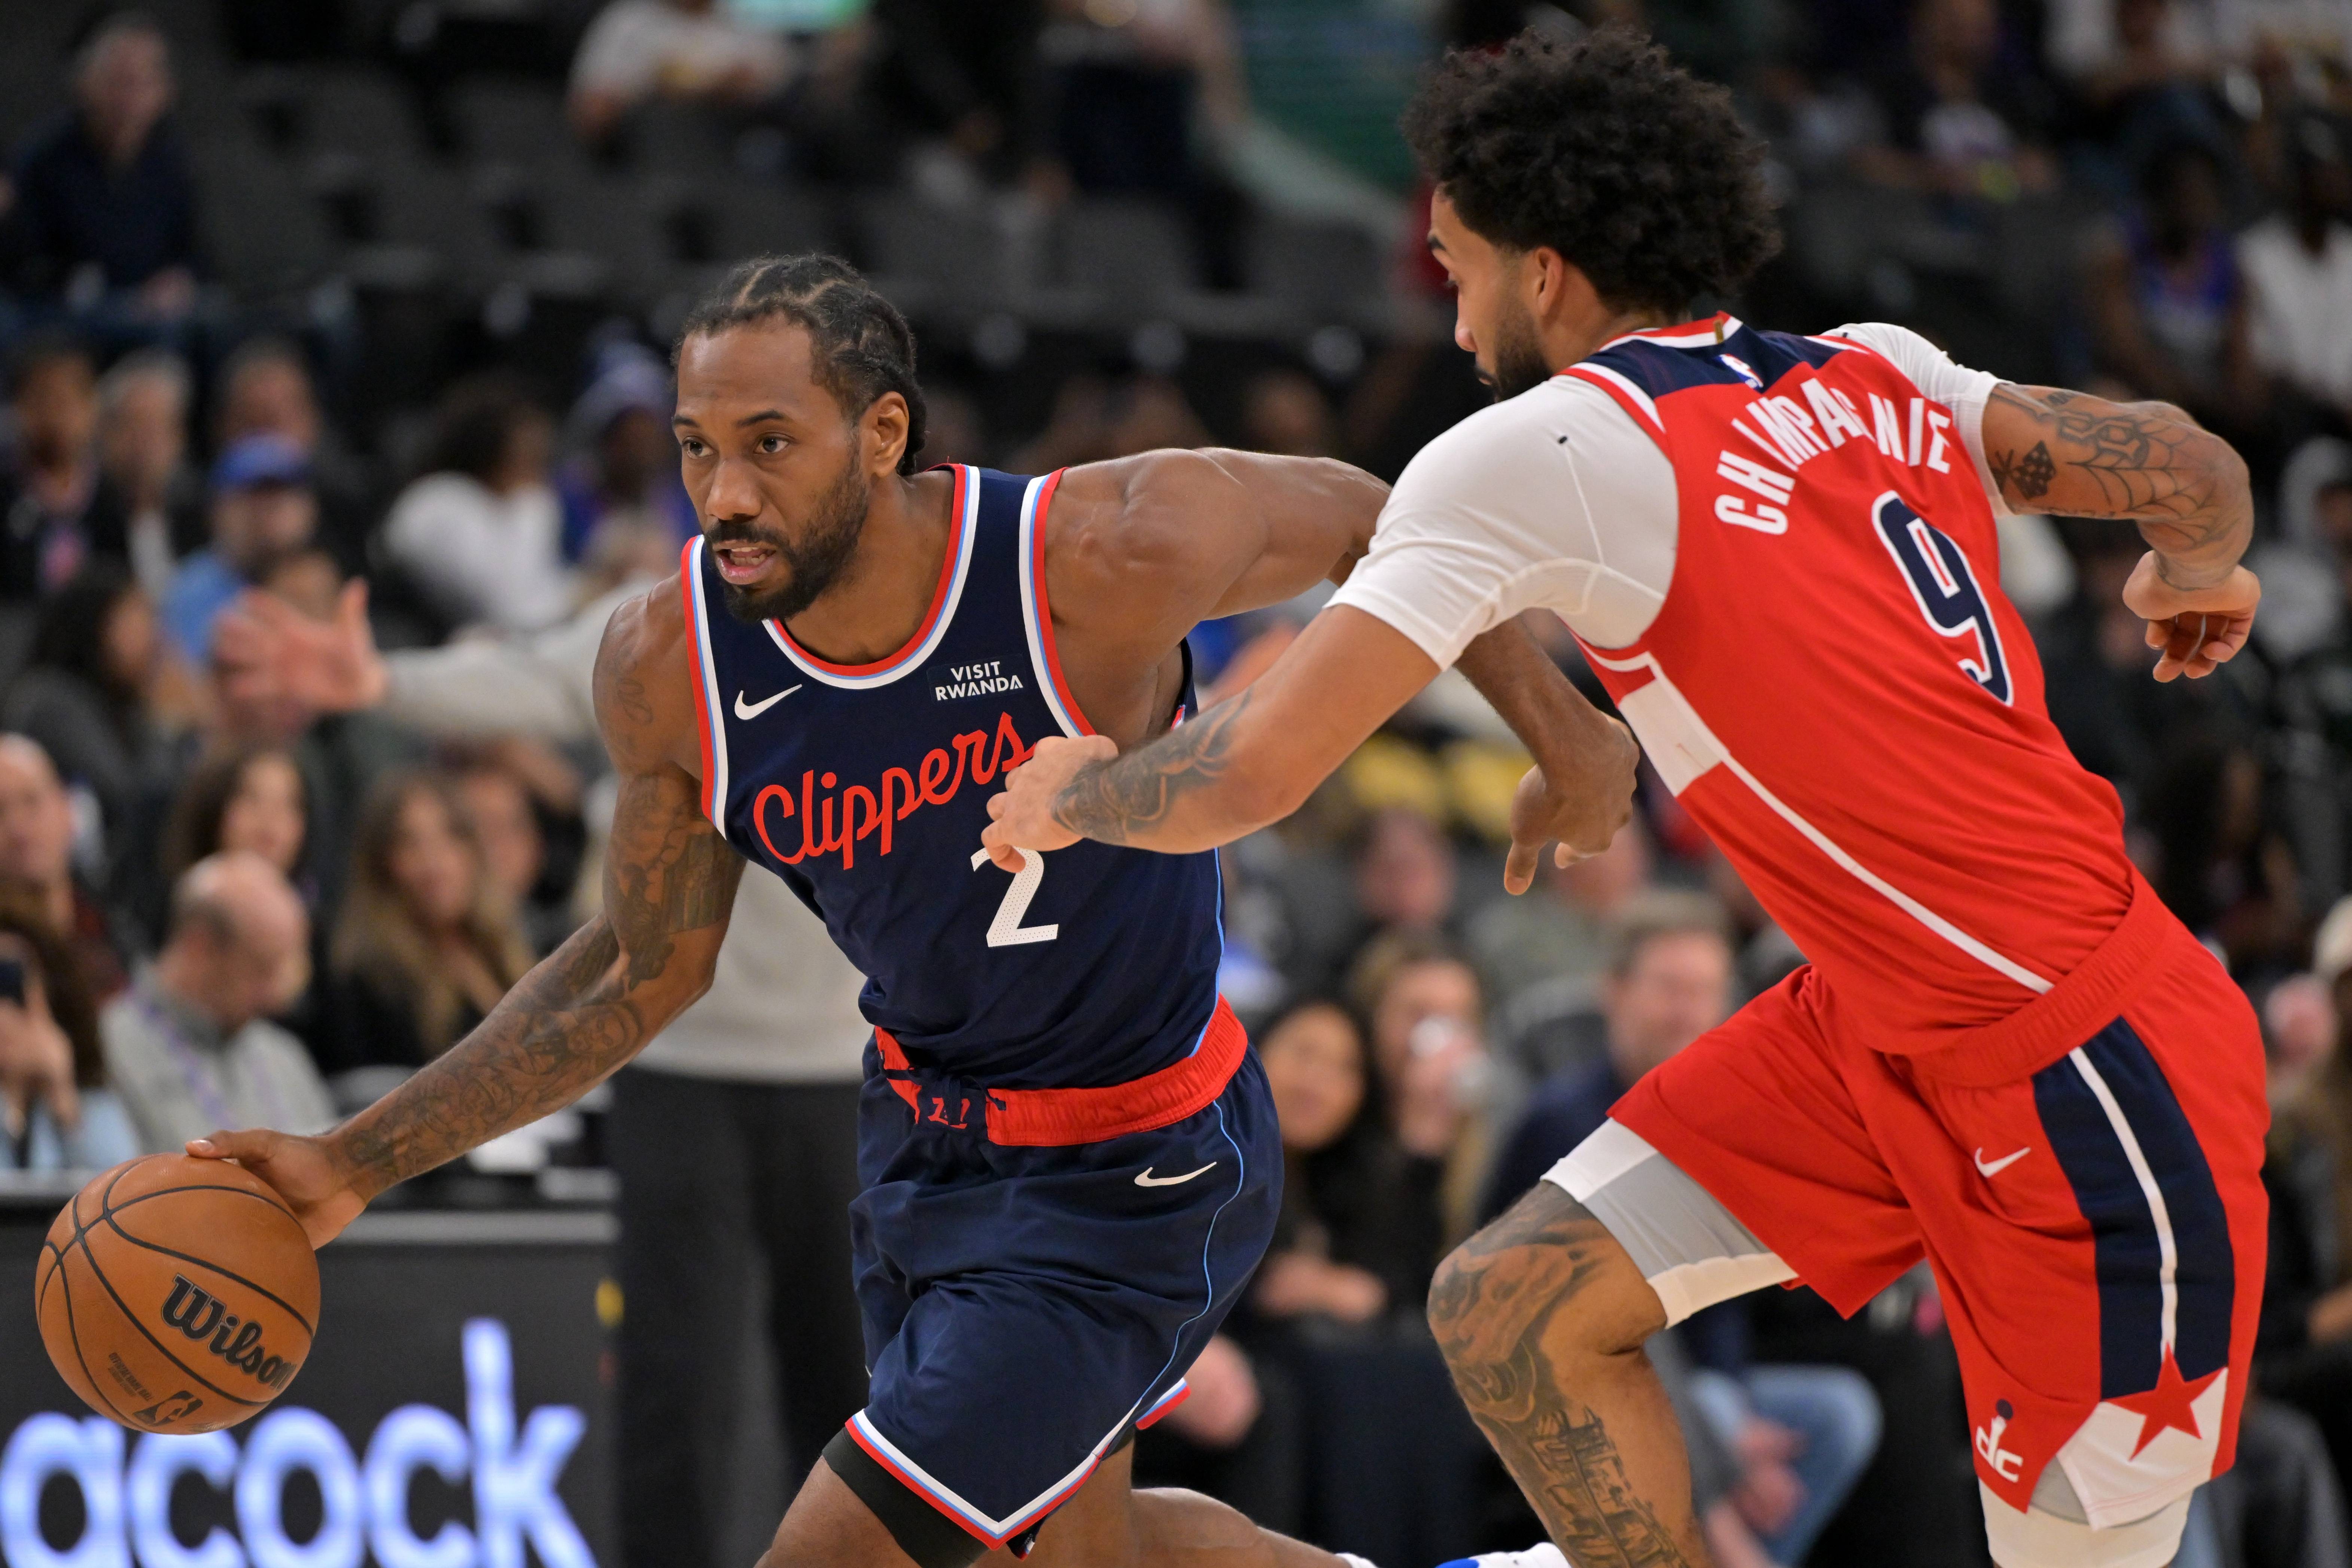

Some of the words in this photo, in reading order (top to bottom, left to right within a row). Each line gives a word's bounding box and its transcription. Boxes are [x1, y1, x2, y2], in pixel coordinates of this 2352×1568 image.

[1714, 377, 1951, 535] CHIMPAGNIE
[1871, 490, 2014, 707] 9
[935, 675, 1023, 701] RWANDA
[950, 661, 1000, 681] VISIT
[753, 711, 1037, 870] Clippers
[971, 846, 1059, 947] 2
[161, 1273, 296, 1391] Wilson
[0, 1316, 600, 1568] acock
